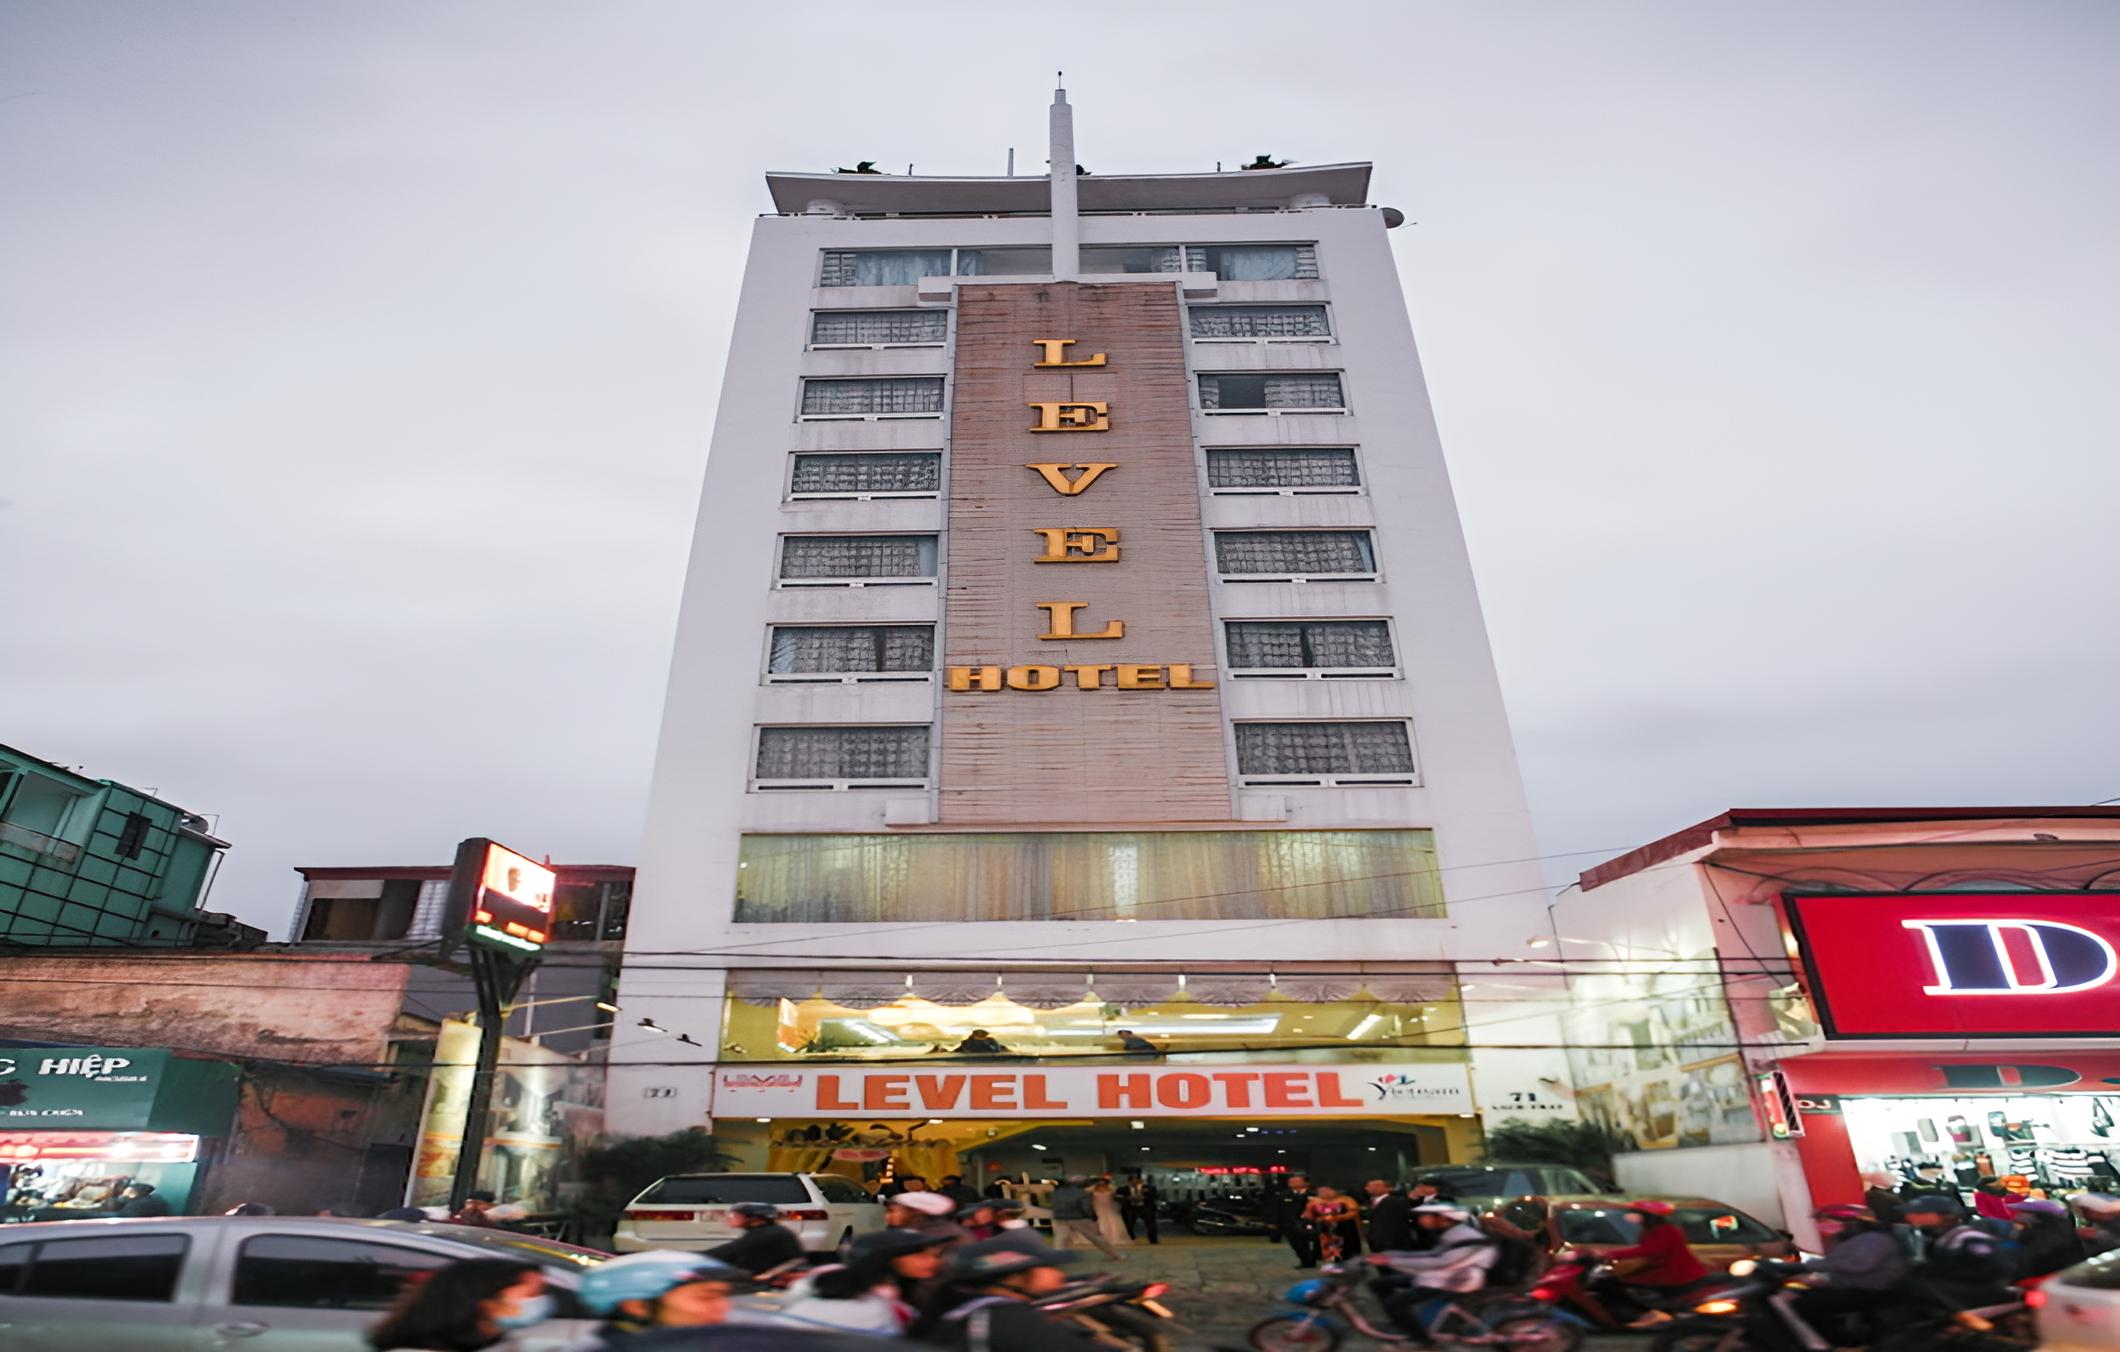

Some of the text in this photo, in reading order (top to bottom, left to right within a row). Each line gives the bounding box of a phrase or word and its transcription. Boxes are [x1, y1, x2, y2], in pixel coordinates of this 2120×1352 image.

[1025, 339, 1126, 641] LEVEL
[945, 663, 1218, 691] HOTEL
[38, 1054, 131, 1078] HIỆP
[816, 1072, 1364, 1110] LEVEL HOTEL
